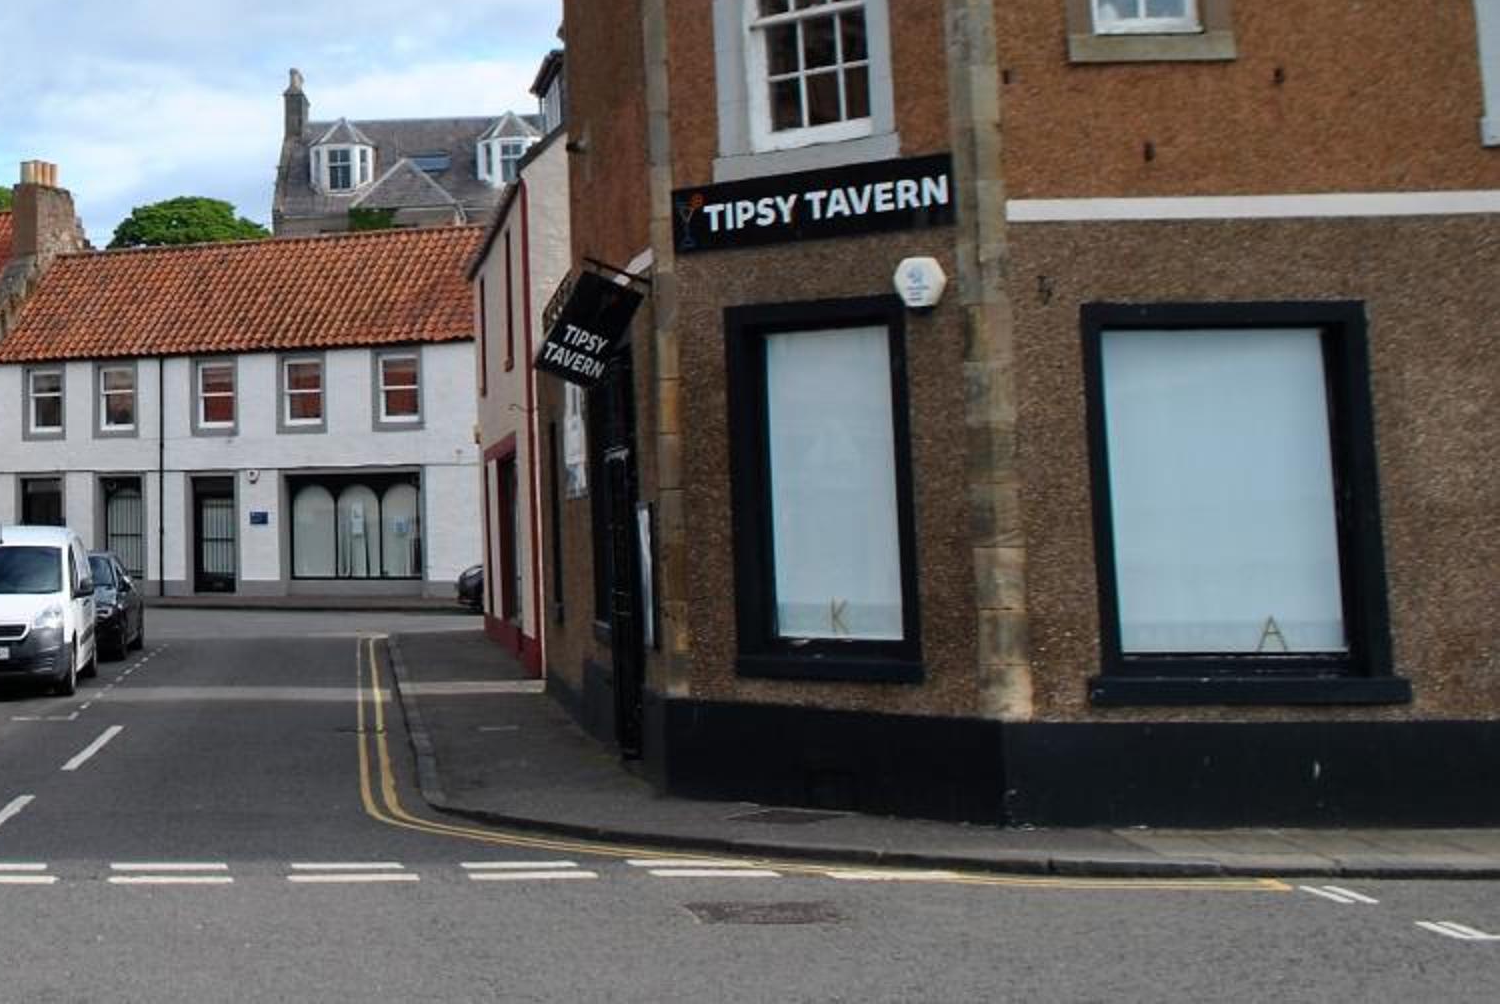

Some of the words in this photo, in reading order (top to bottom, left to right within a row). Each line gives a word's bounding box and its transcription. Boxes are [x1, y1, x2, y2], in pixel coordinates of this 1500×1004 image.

[703, 194, 798, 232] TIPSY
[803, 175, 949, 221] TAVERN
[563, 324, 609, 355] TIPSY
[544, 341, 606, 379] TAVERN
